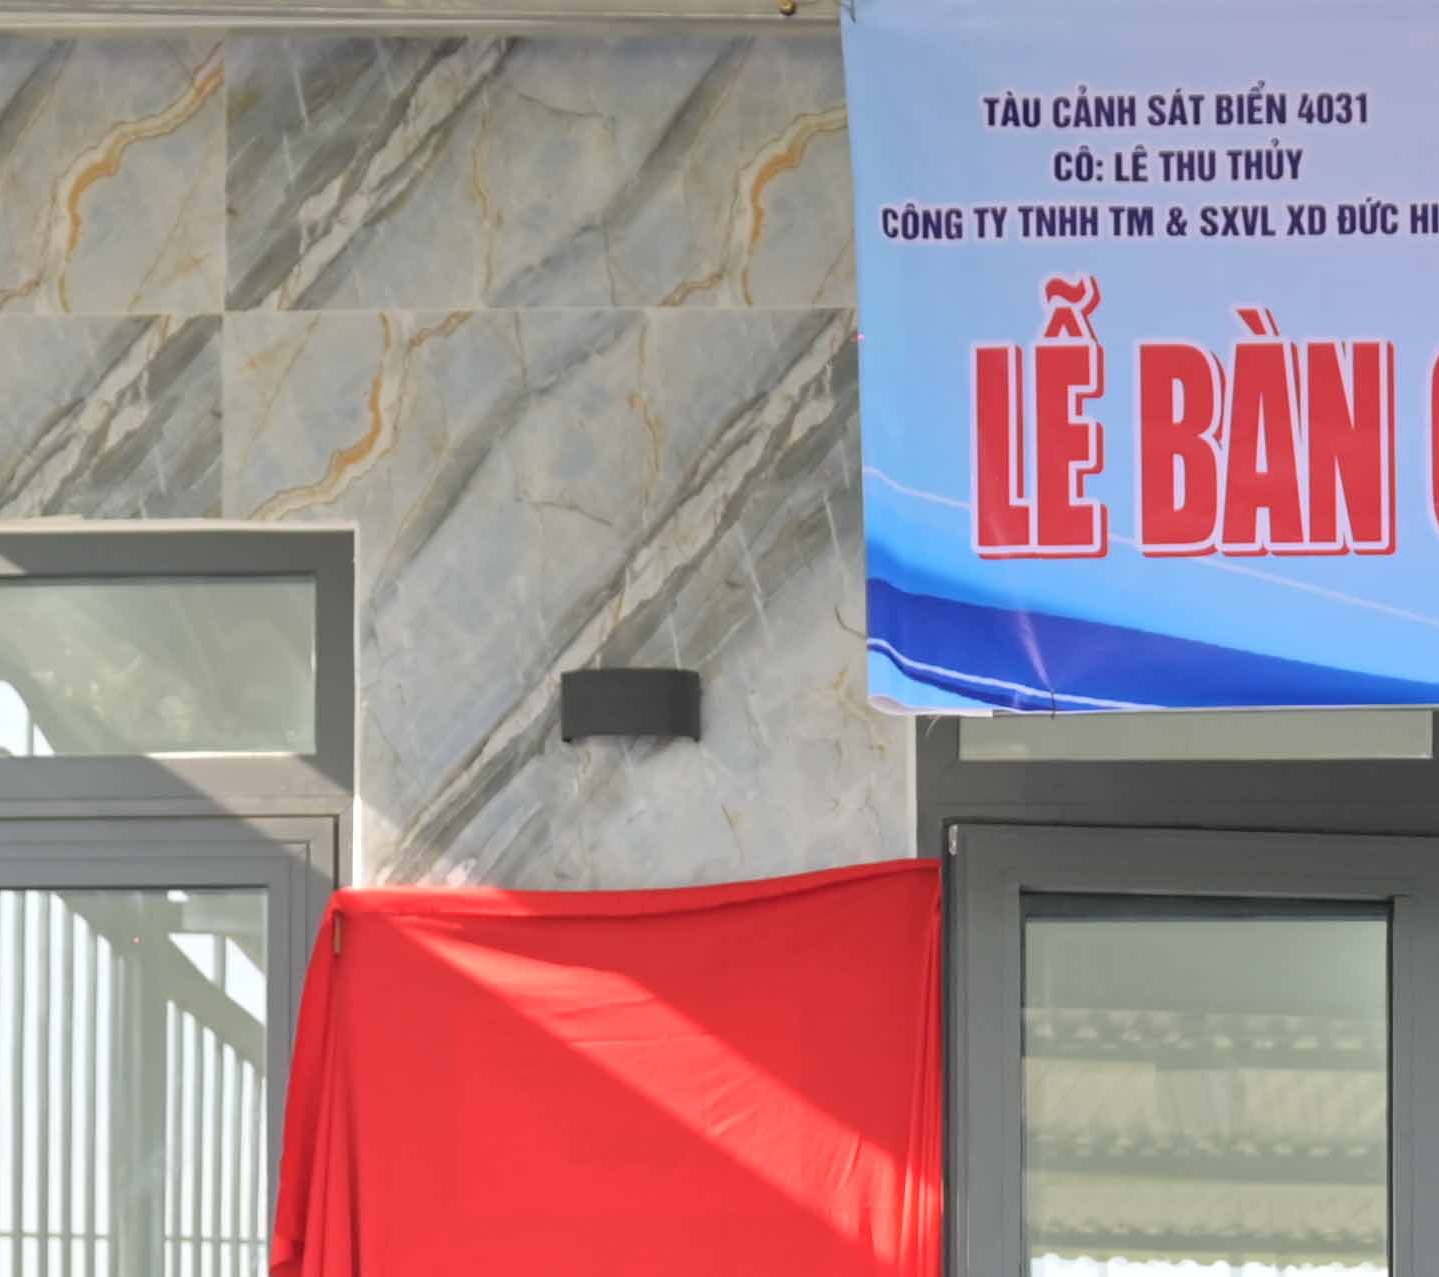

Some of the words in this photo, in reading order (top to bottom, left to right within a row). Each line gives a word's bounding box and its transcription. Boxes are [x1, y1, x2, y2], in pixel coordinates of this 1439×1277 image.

[984, 91, 1041, 131] TÀU
[1052, 84, 1137, 129] CẢNH
[1146, 88, 1209, 128] SÁT
[1215, 81, 1286, 126] BIỂN
[1296, 93, 1369, 125] 4031
[1052, 148, 1103, 183] CÔ:
[1114, 146, 1149, 183] LÊ
[1160, 150, 1216, 182] THU
[1227, 139, 1303, 181] THỦY
[881, 201, 963, 240] CÔNG
[974, 206, 1009, 239] TY
[1018, 206, 1099, 238] TNHH
[1108, 206, 1155, 237] TM
[1166, 205, 1187, 238] &
[1199, 204, 1277, 237] SXVL
[1286, 204, 1326, 236] XD
[1336, 194, 1400, 236] ĐỨC
[972, 275, 1107, 558] LỄ
[1138, 307, 1395, 557] BÀN
